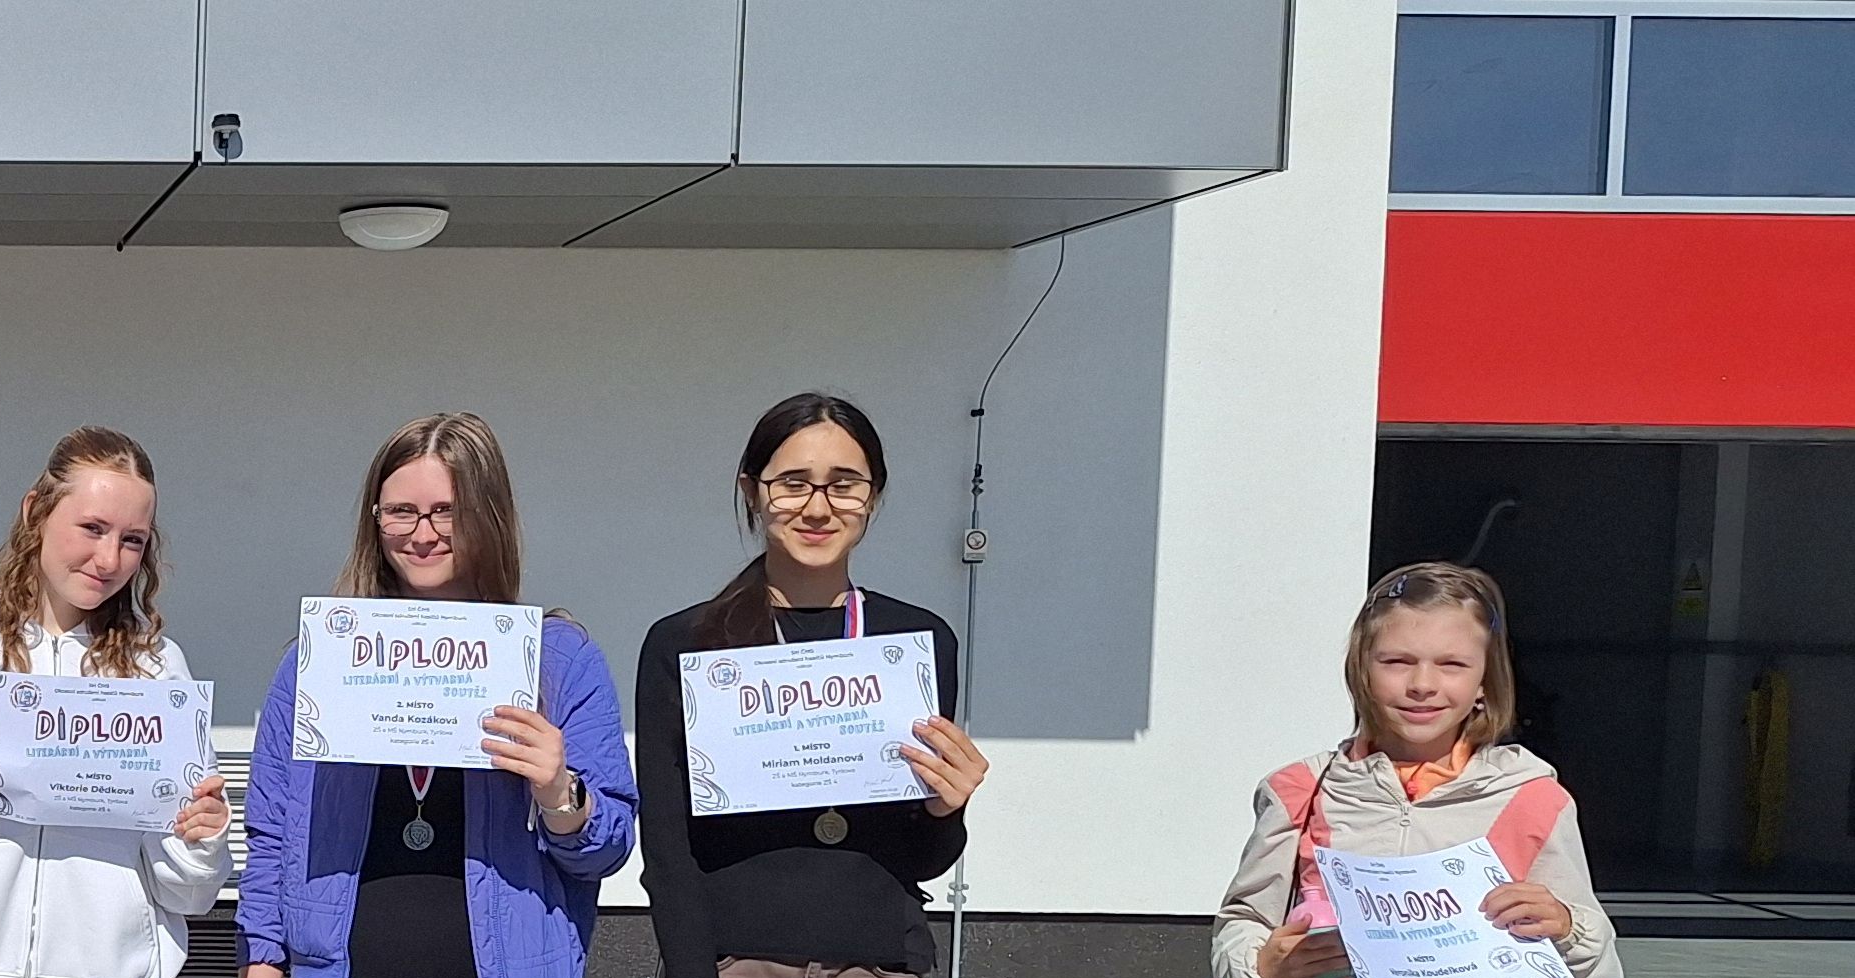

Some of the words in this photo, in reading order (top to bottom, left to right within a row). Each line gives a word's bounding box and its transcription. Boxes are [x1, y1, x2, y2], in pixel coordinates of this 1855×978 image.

[352, 631, 487, 670] DIPLOM
[403, 677, 410, 686] A
[740, 675, 882, 717] DIPLOM
[407, 700, 434, 709] MÍSTO
[372, 713, 404, 722] Vanda
[408, 714, 457, 724] Kozáková
[35, 707, 162, 744] DIPLOM
[797, 720, 804, 730] A
[802, 742, 830, 750] MÍSTO
[83, 749, 90, 759] A
[762, 759, 799, 769] Miriam
[803, 753, 863, 766] Moldanová
[86, 772, 111, 780] MÍSTO
[50, 783, 88, 792] Viktorie
[1355, 886, 1462, 926] DIPLOM
